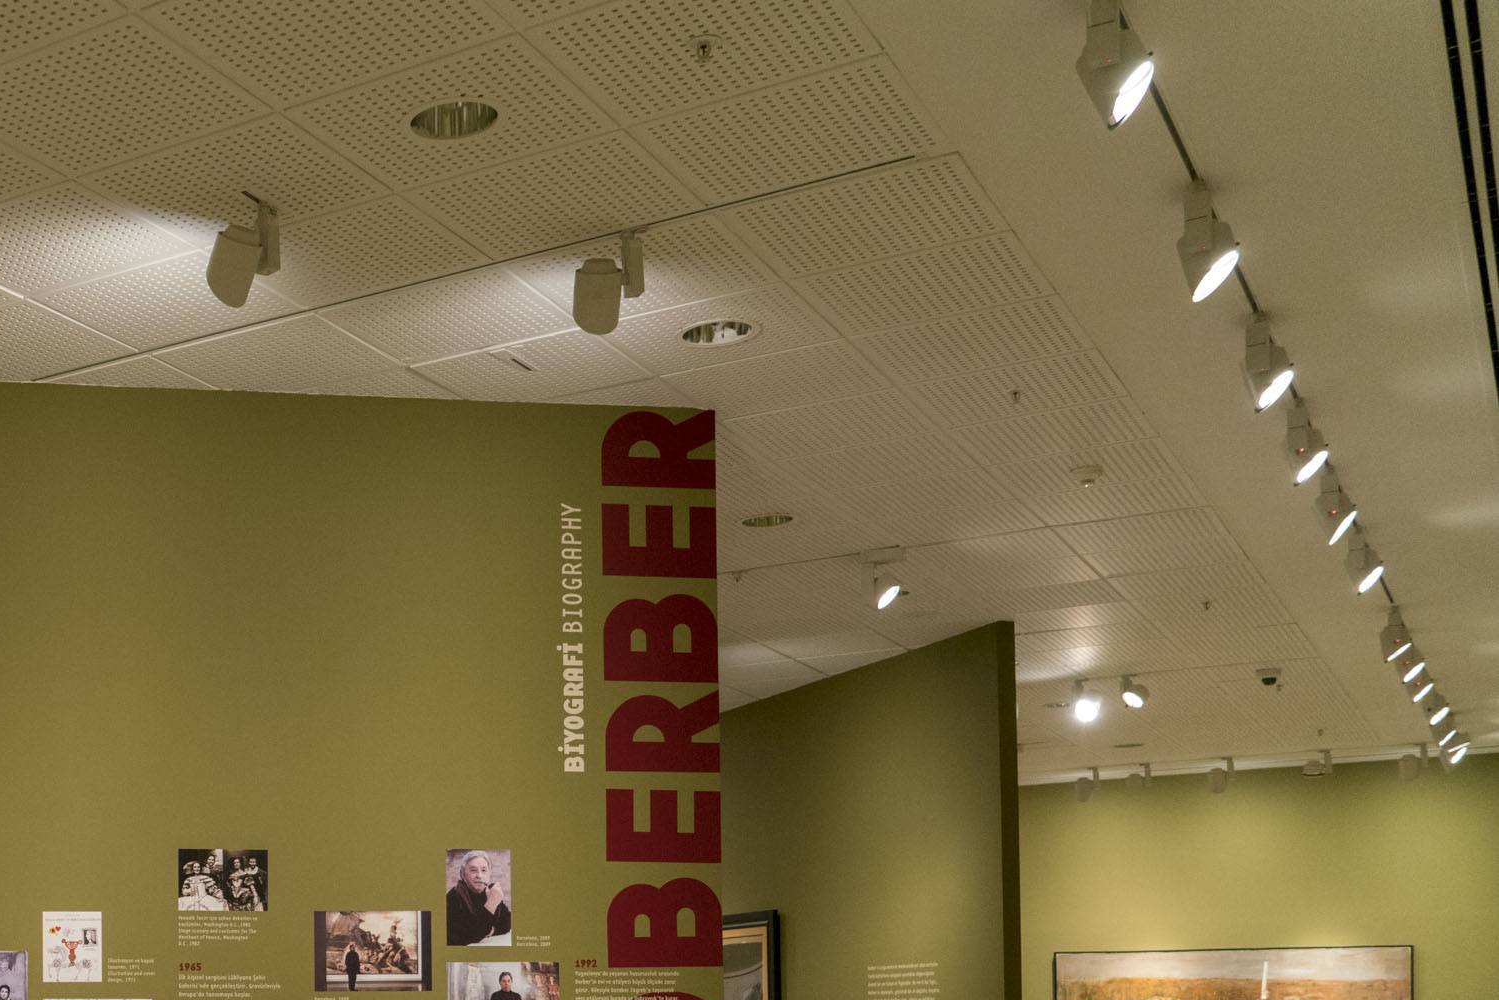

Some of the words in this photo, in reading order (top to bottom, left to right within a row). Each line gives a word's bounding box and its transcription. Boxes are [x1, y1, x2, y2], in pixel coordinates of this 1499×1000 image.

[560, 503, 583, 633] BIOGRAPHY
[557, 642, 585, 773] BİYOGRAFİ
[601, 410, 724, 968] BERBER
[179, 963, 202, 971] 1965
[575, 960, 597, 968] 1992
